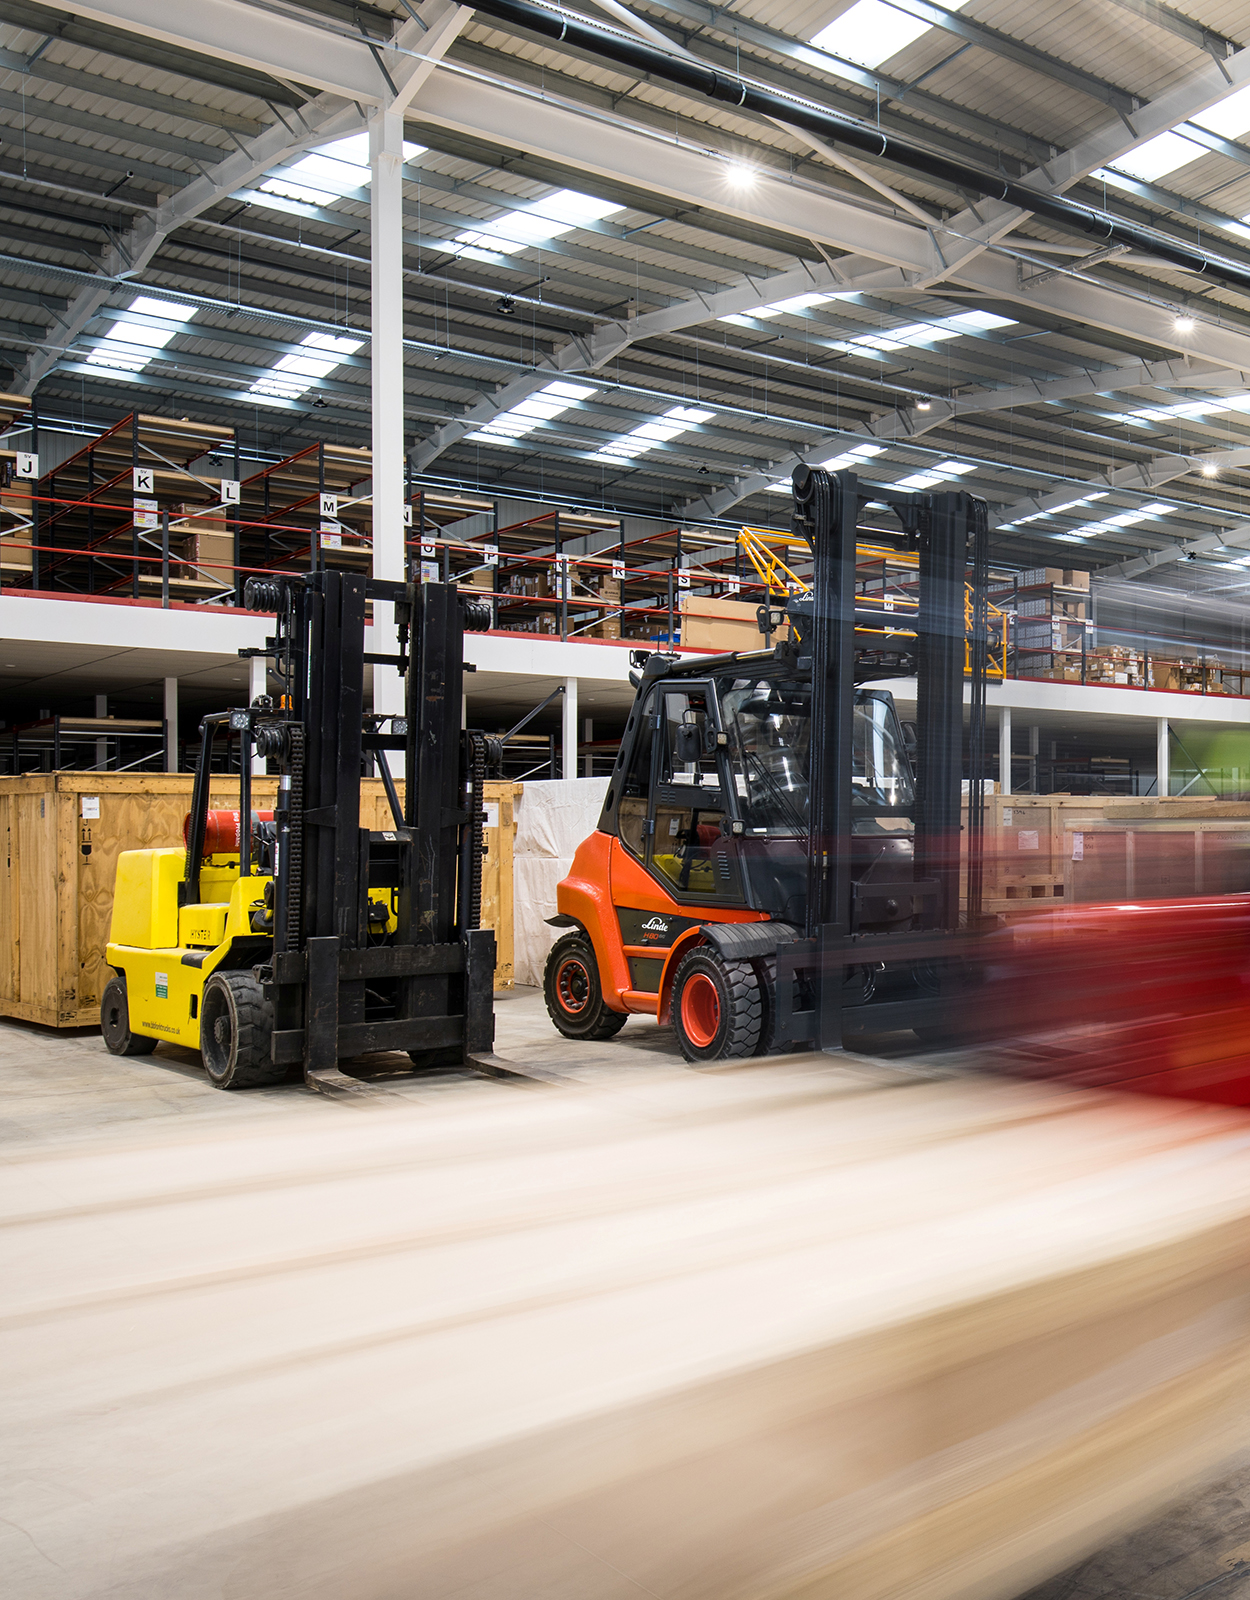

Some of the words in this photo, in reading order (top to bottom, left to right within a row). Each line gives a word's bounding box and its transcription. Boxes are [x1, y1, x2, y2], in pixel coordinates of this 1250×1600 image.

[22, 461, 32, 474] J
[137, 475, 150, 489] K
[226, 487, 236, 500] L
[323, 501, 334, 512] M
[641, 916, 668, 931] Linde
[190, 929, 211, 940] HYSTER
